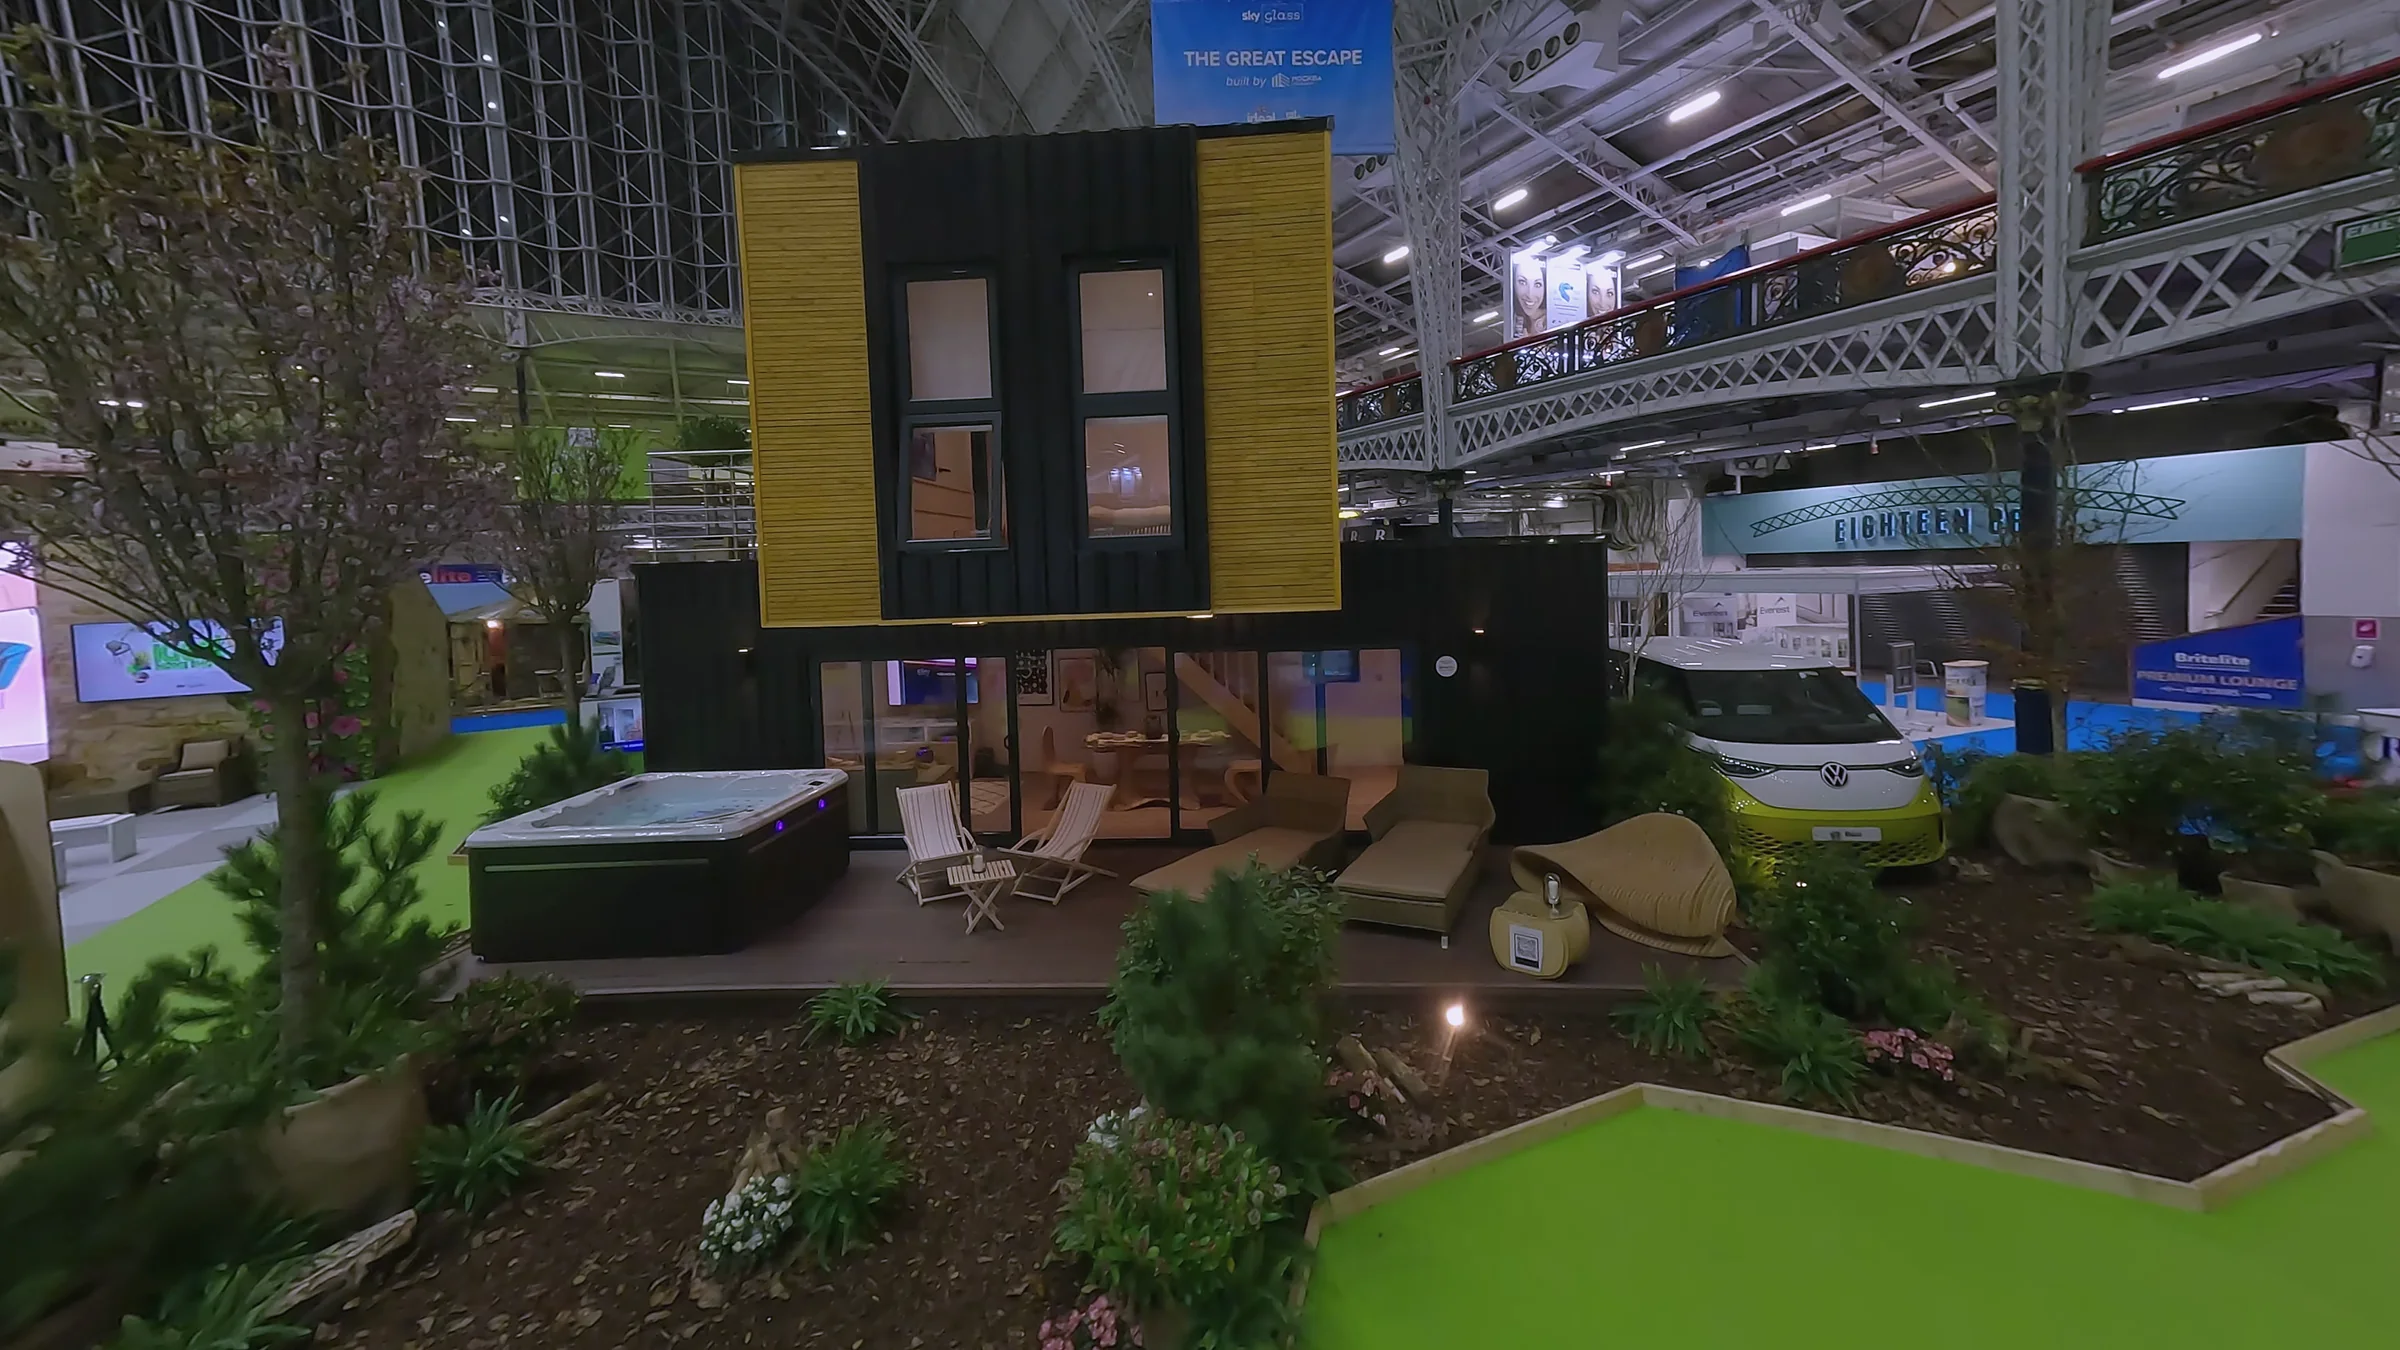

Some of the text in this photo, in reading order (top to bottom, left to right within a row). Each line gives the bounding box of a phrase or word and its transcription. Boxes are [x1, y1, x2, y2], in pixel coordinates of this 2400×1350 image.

[1242, 9, 1301, 24] sky glass
[1183, 49, 1363, 67] THE GREAT ESCAPE
[1226, 76, 1267, 88] built by
[1835, 508, 1972, 543] EIGHTEEN
[1760, 606, 1790, 615] Everest
[2175, 652, 2251, 666] Britelite
[2136, 671, 2298, 691] PREMIUM LOUNGE
